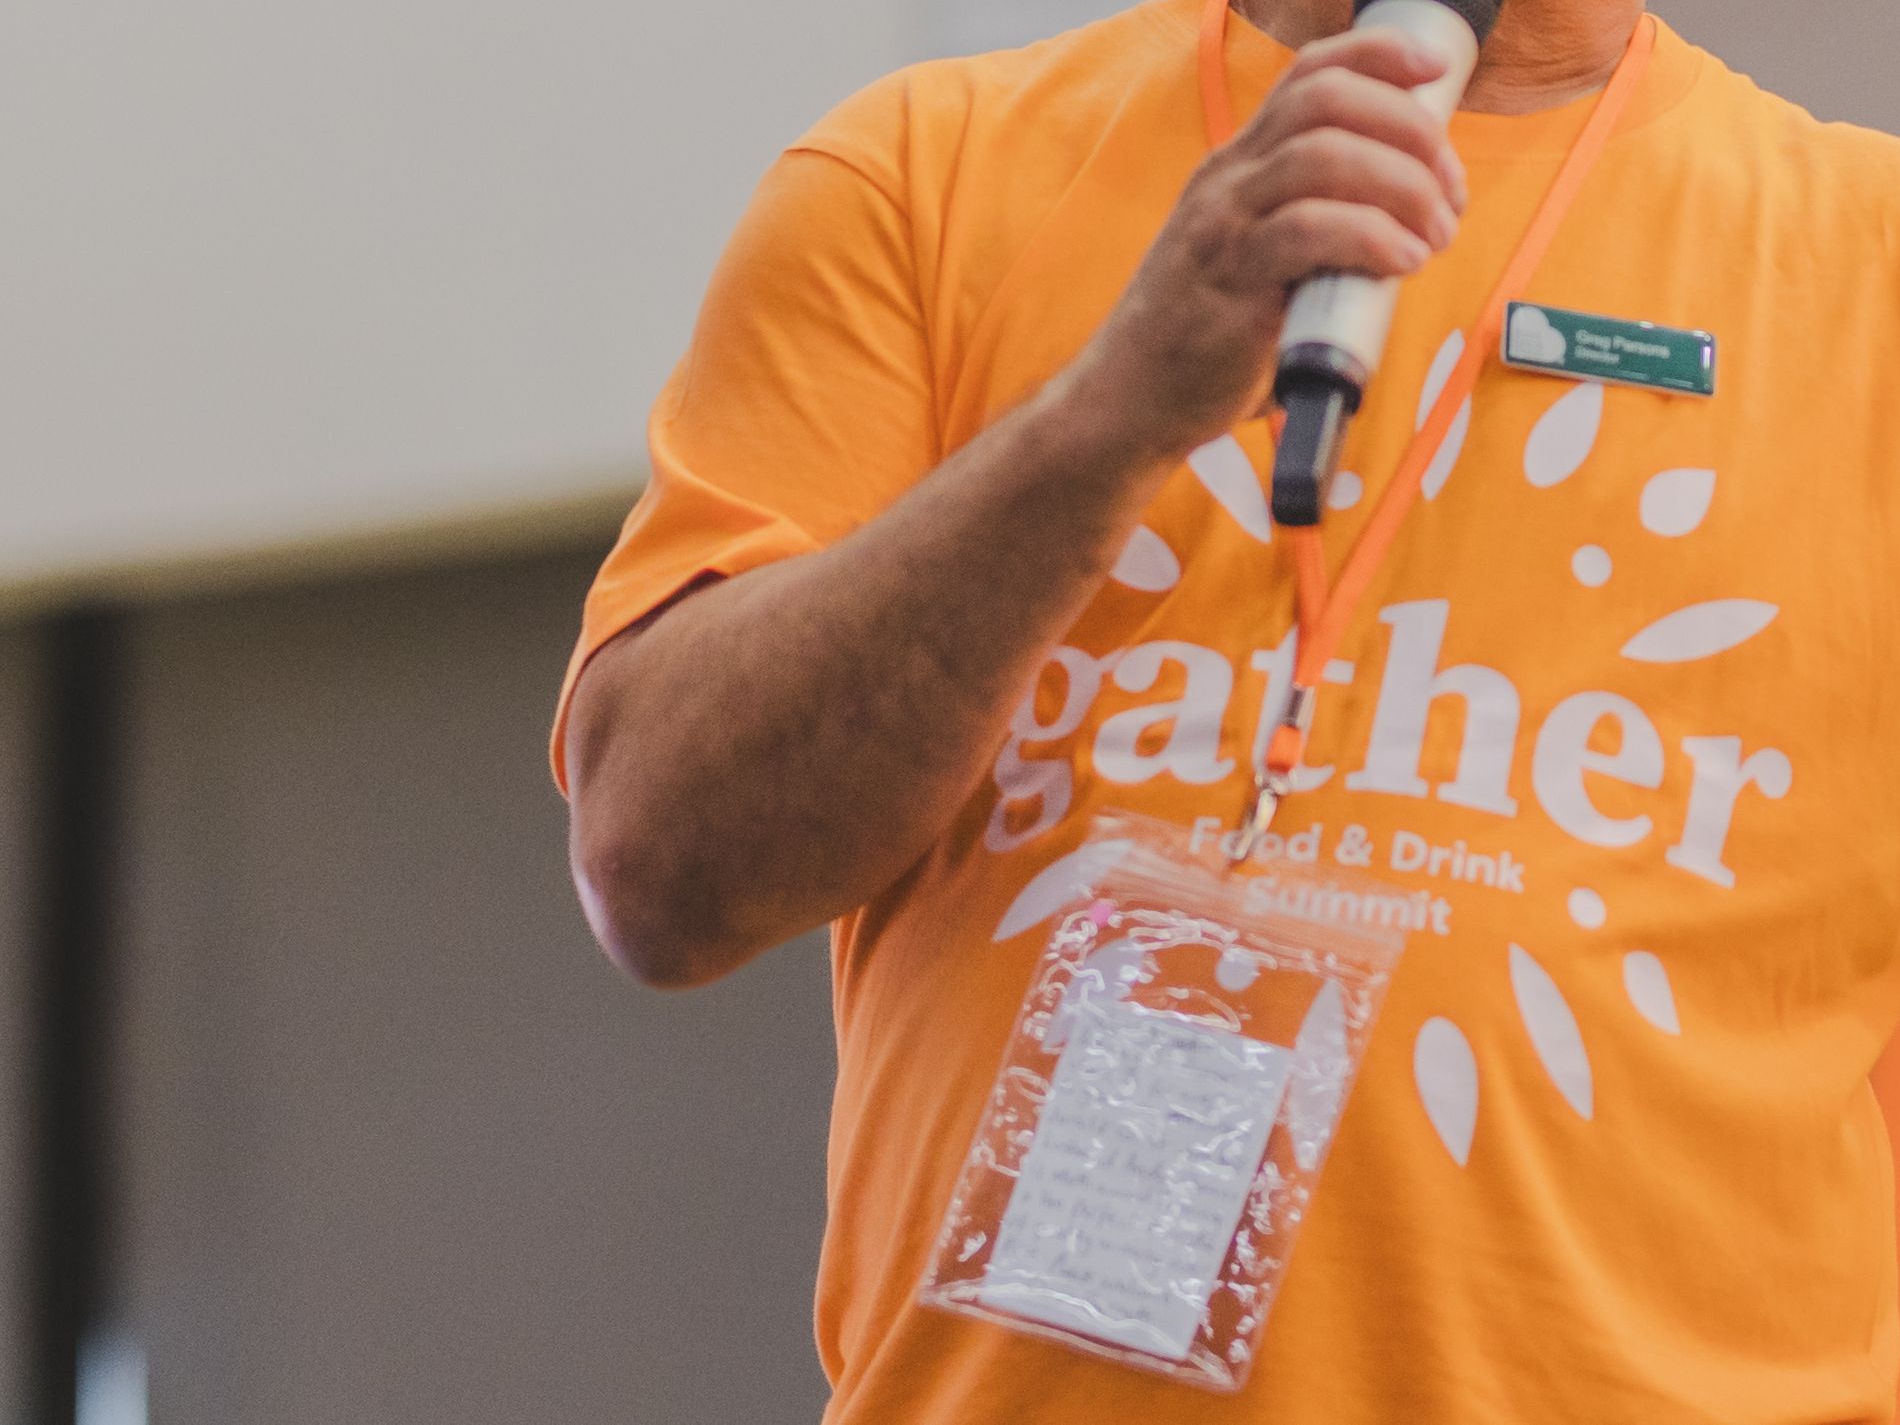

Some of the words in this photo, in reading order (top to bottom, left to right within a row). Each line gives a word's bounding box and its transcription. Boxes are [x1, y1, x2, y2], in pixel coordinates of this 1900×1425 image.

[984, 598, 1793, 889] gather
[1334, 823, 1374, 868] &
[1390, 829, 1525, 894] Drink
[1241, 875, 1452, 937] Summit
